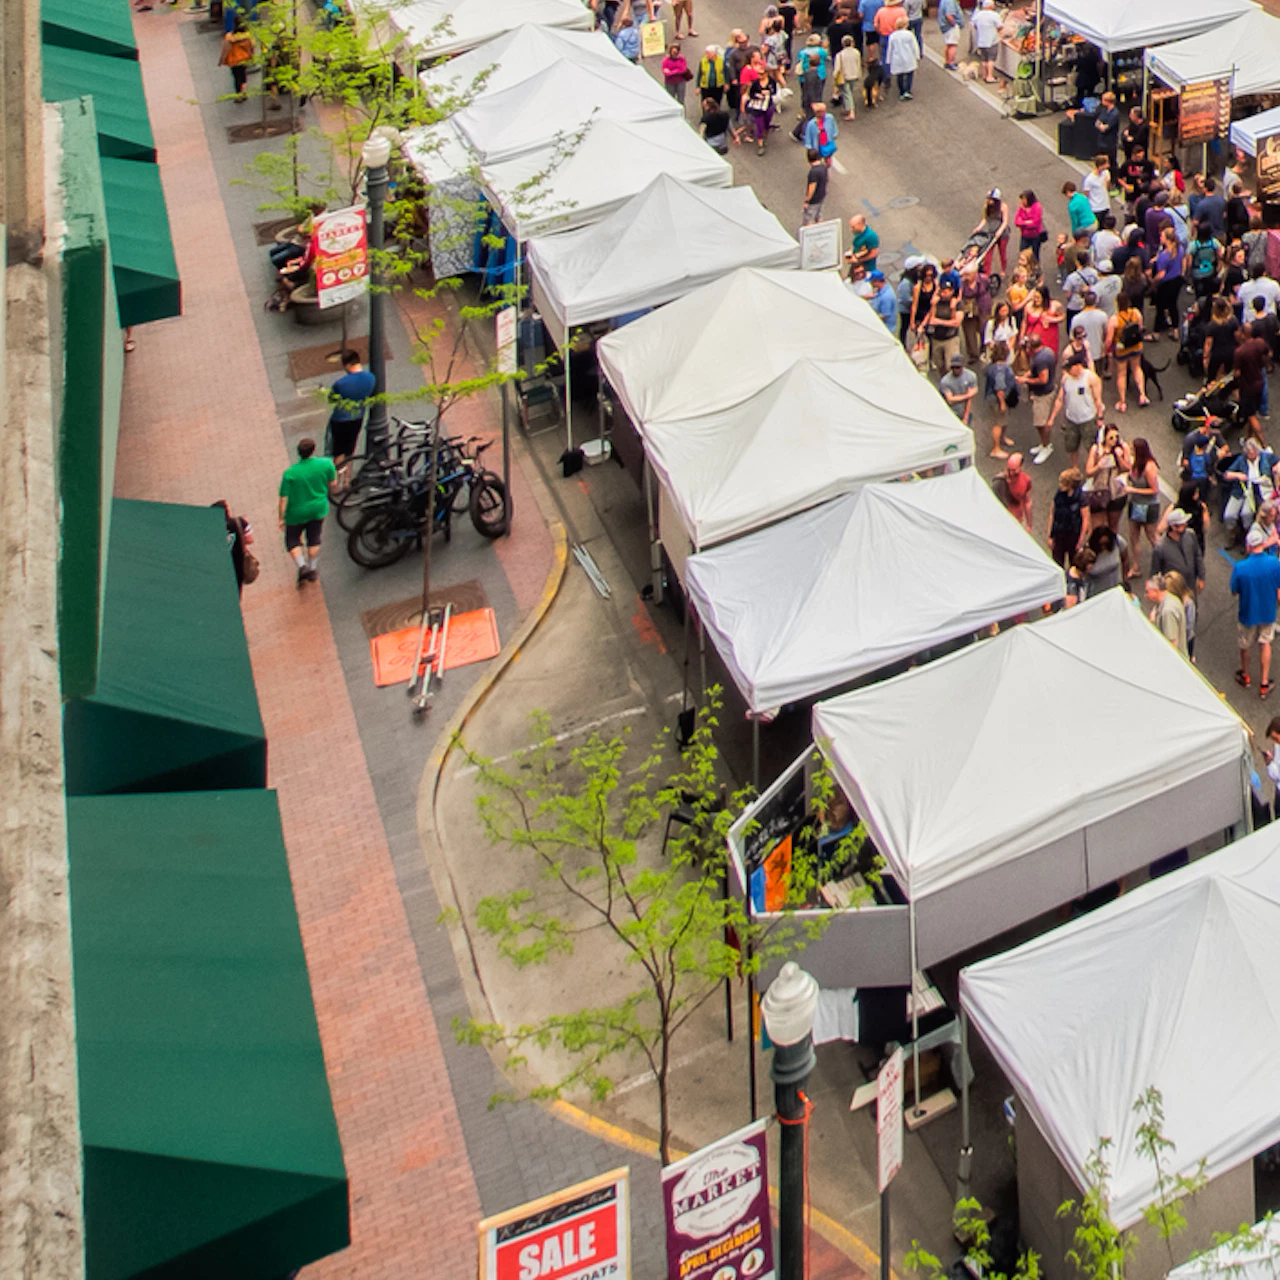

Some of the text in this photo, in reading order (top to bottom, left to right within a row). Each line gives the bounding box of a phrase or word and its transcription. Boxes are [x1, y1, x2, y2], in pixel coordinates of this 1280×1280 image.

[673, 1159, 761, 1218] MARKET
[703, 1166, 729, 1187] The
[518, 1221, 597, 1280] SALE
